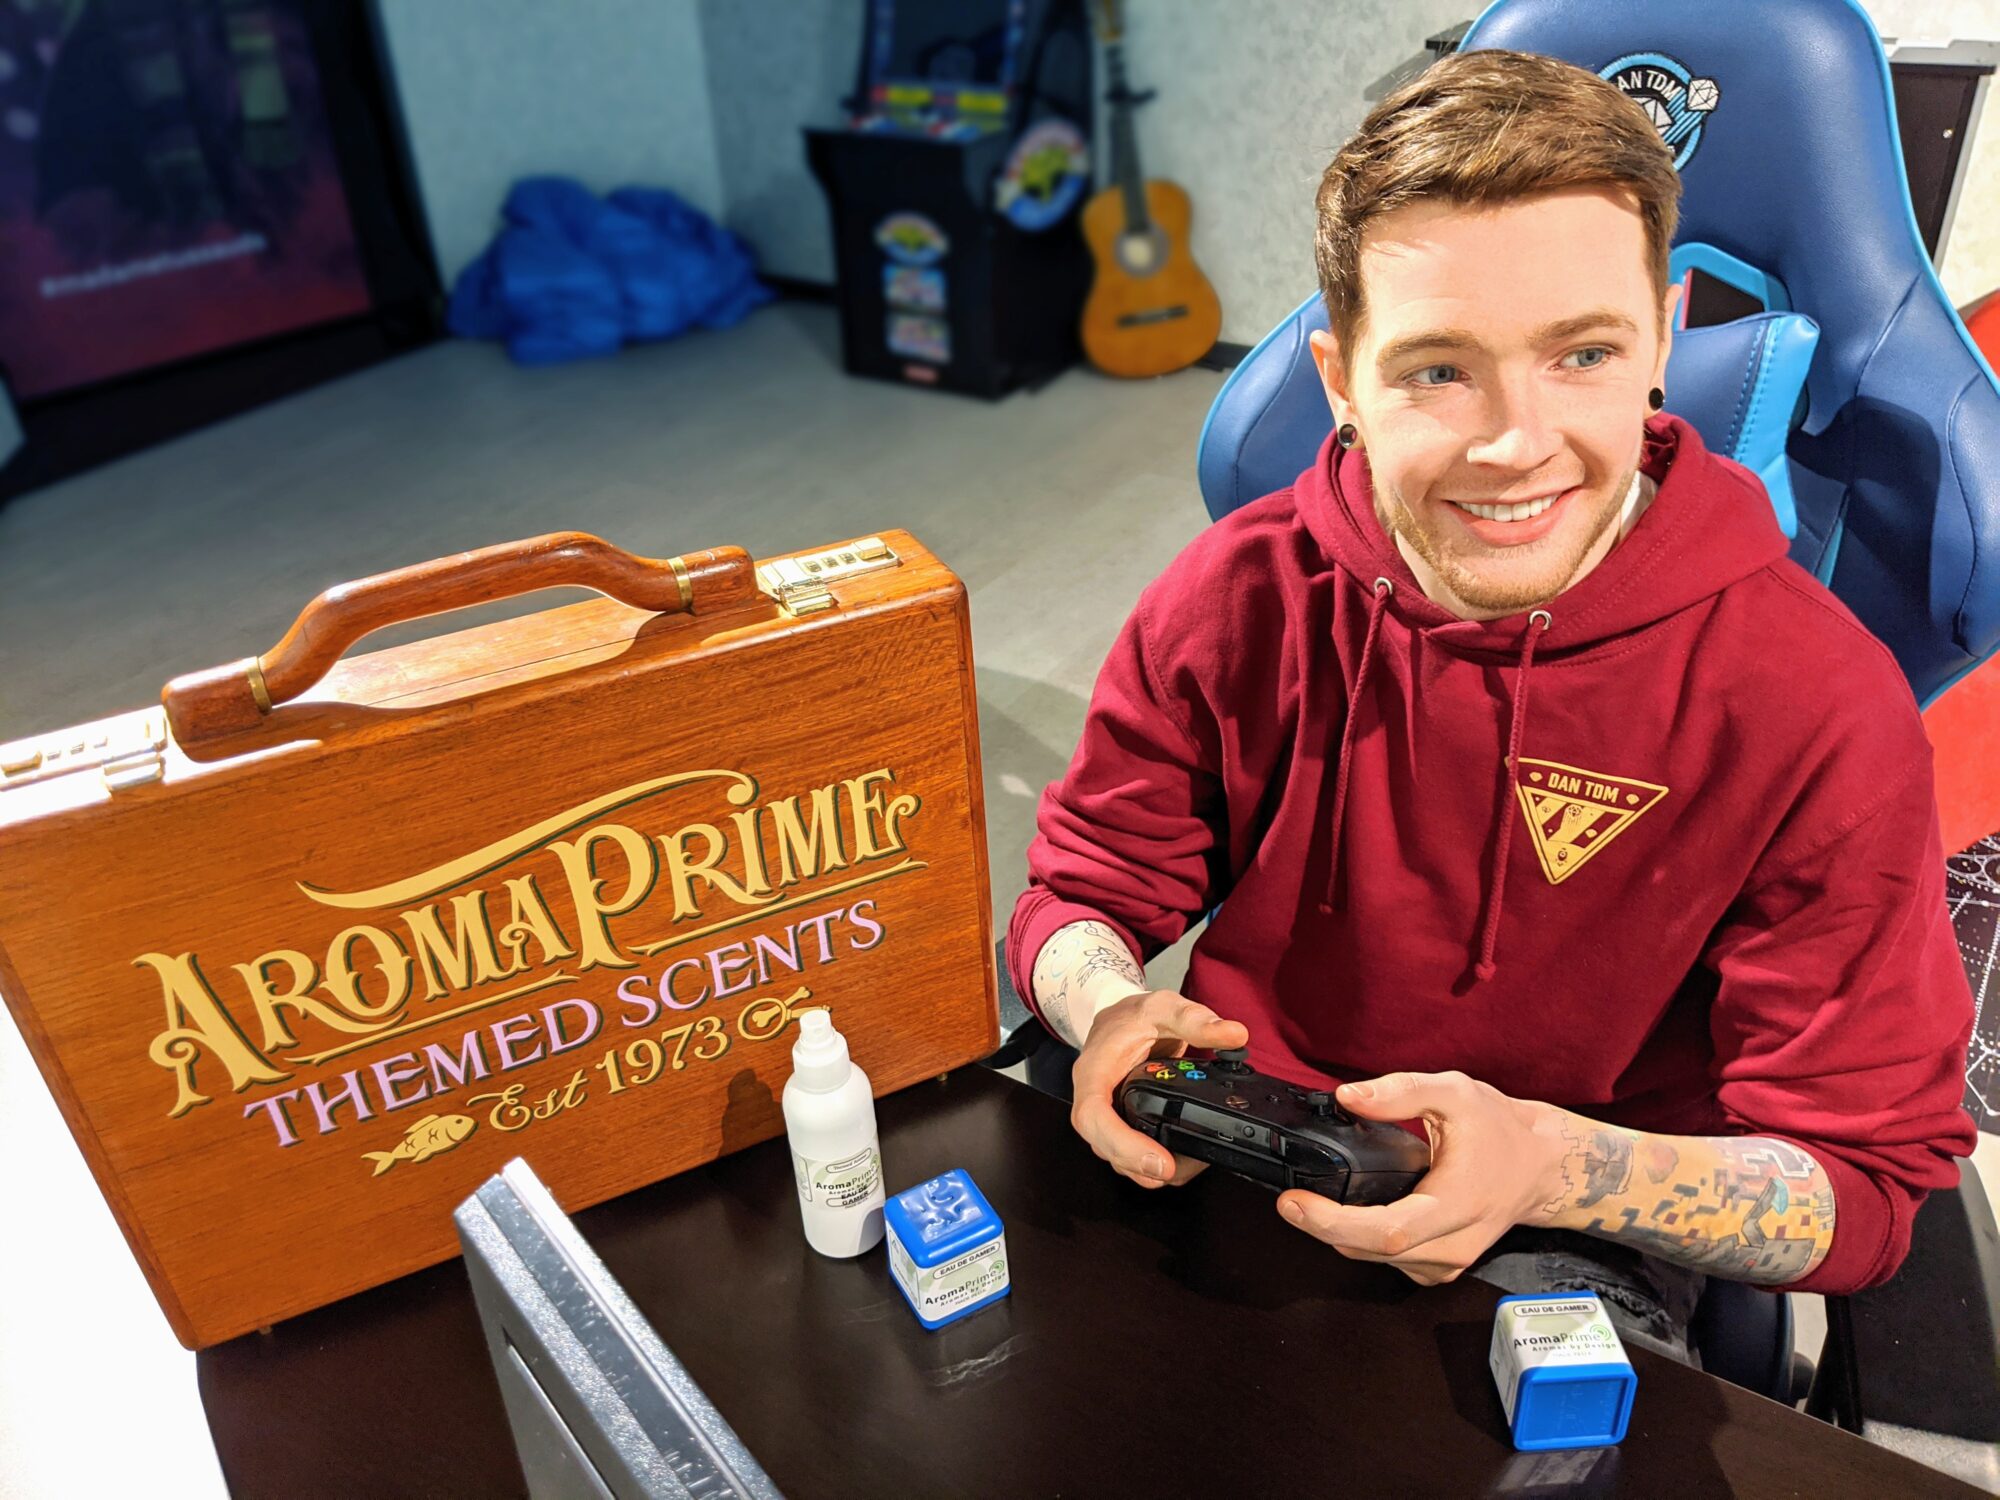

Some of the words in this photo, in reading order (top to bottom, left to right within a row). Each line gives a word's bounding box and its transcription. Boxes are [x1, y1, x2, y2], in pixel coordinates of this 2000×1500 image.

[1617, 71, 1642, 92] AN
[1548, 772, 1581, 794] DAN
[243, 998, 603, 1148] THEMED
[617, 900, 884, 1028] SCENTS
[467, 1069, 588, 1132] Est
[595, 1016, 731, 1095] 1973
[940, 1264, 956, 1275] EAU
[957, 1259, 968, 1267] DE
[969, 1245, 996, 1262] GAMER
[925, 1270, 997, 1305] AromaPrime
[1521, 1306, 1541, 1314] EAU
[1542, 1305, 1555, 1313] DE
[1556, 1304, 1590, 1312] GAMER
[1513, 1331, 1601, 1350] AromaPrime
